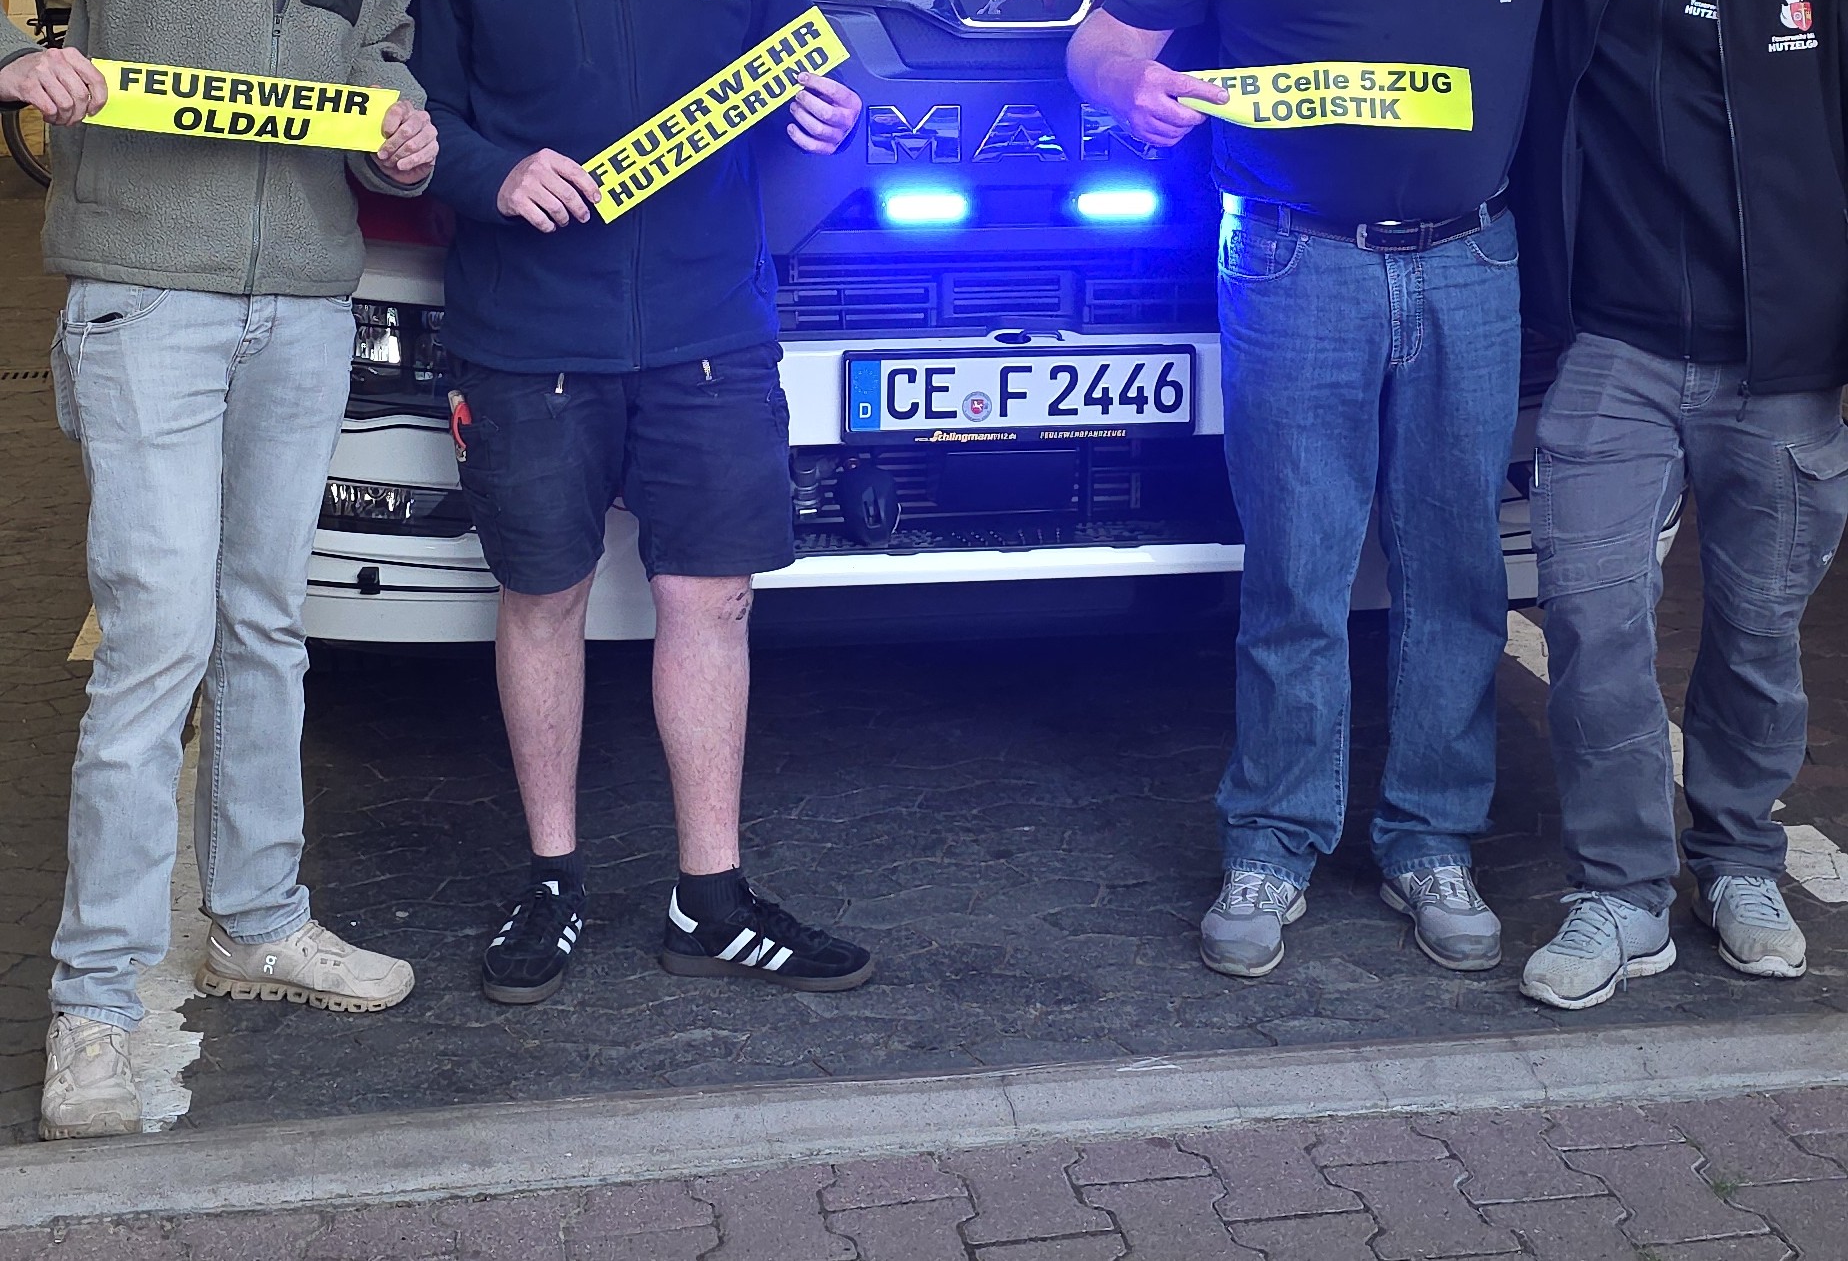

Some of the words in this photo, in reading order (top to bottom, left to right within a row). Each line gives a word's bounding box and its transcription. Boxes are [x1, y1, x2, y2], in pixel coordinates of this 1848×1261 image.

[119, 66, 371, 116] FEUERWEHR
[587, 20, 822, 189] FEUERWEHR
[1199, 74, 1261, 96] FB
[1271, 69, 1350, 94] Celle
[1360, 69, 1452, 93] 5.ZUG
[173, 106, 311, 141] OLDAU
[607, 45, 830, 208] HUTZELGRUND
[1253, 95, 1402, 123] LOGISTIK
[859, 402, 872, 419] D
[886, 366, 958, 421] CE
[999, 365, 1033, 418] F
[1047, 361, 1185, 417] 2446
